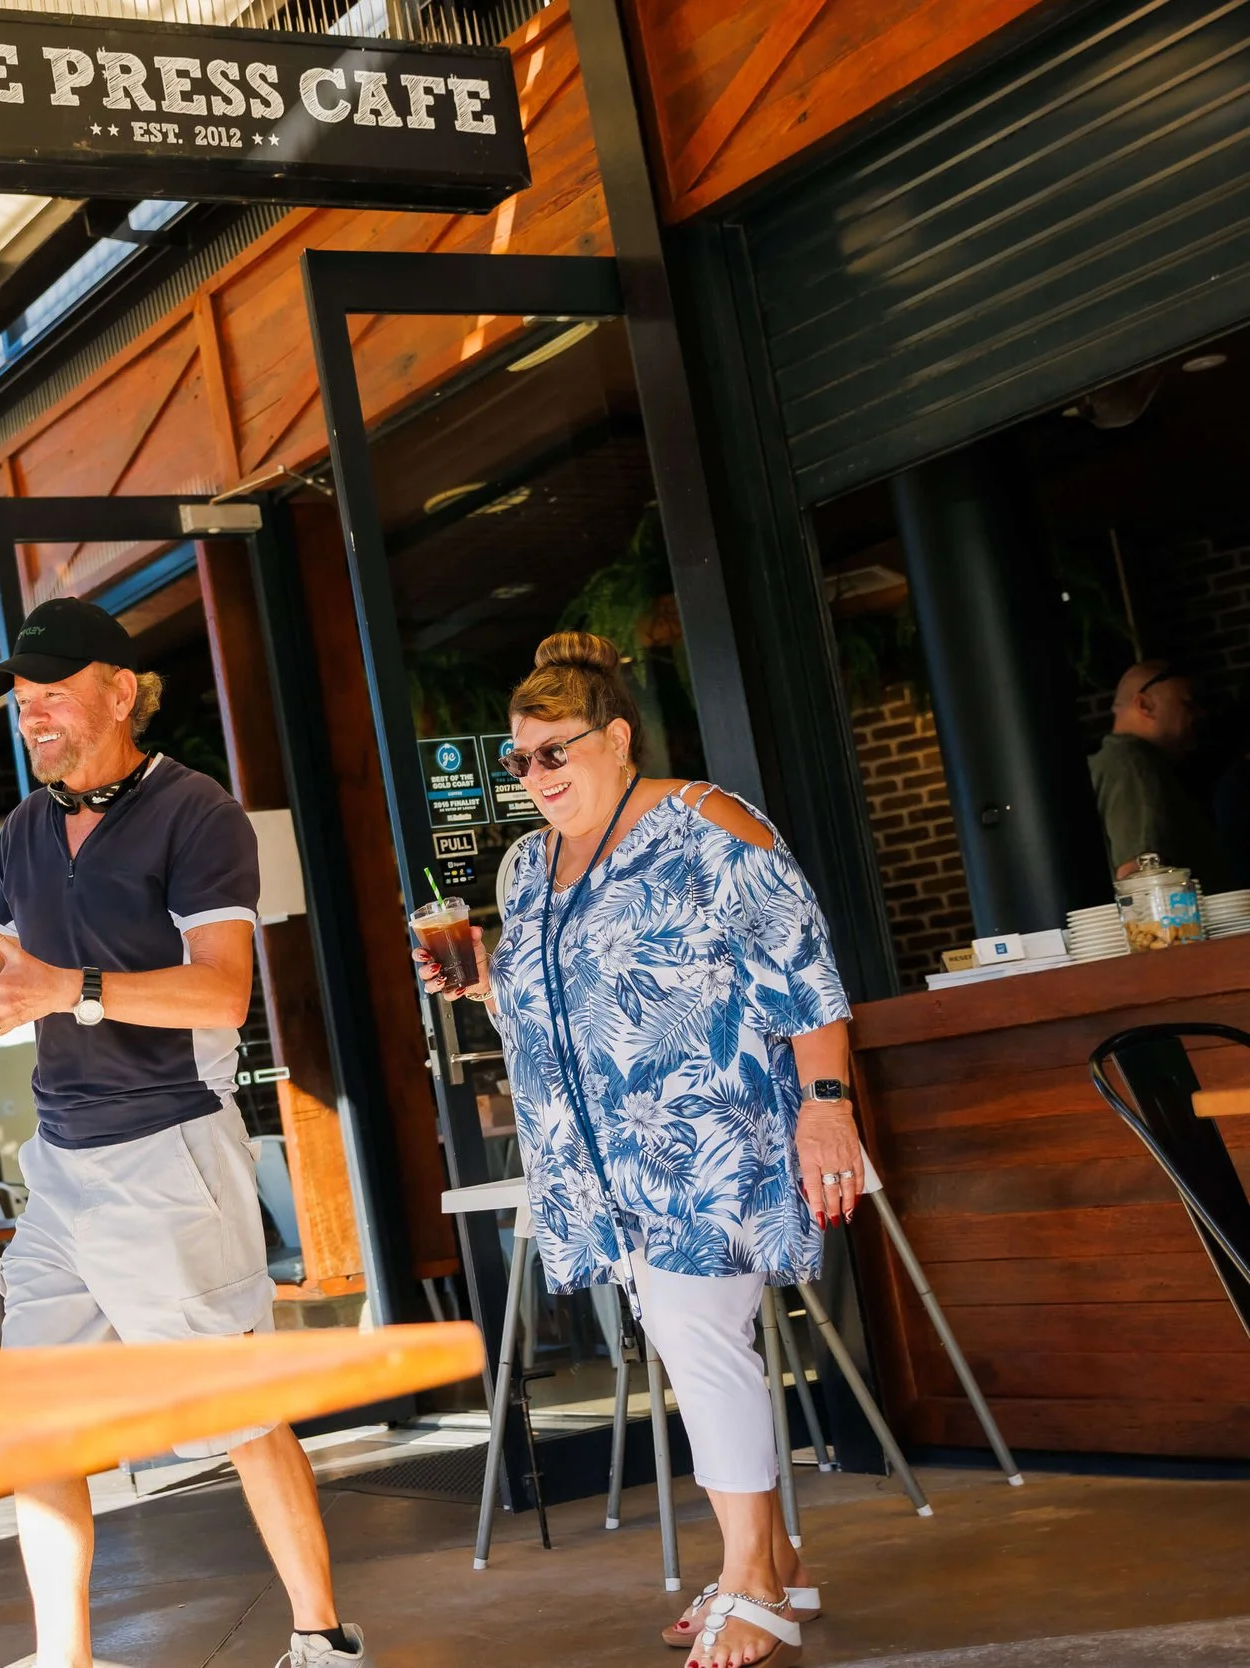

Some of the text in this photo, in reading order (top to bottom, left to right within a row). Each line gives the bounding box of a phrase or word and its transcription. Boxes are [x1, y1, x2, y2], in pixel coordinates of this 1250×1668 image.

[42, 46, 285, 119] PRESS
[299, 68, 497, 134] CAFE
[130, 121, 243, 147] EST. 2012
[18, 626, 46, 640] KLEY
[431, 775, 449, 783] BEST
[452, 780, 474, 788] COAST
[450, 798, 480, 807] FINALIST
[440, 837, 472, 852] PULL
